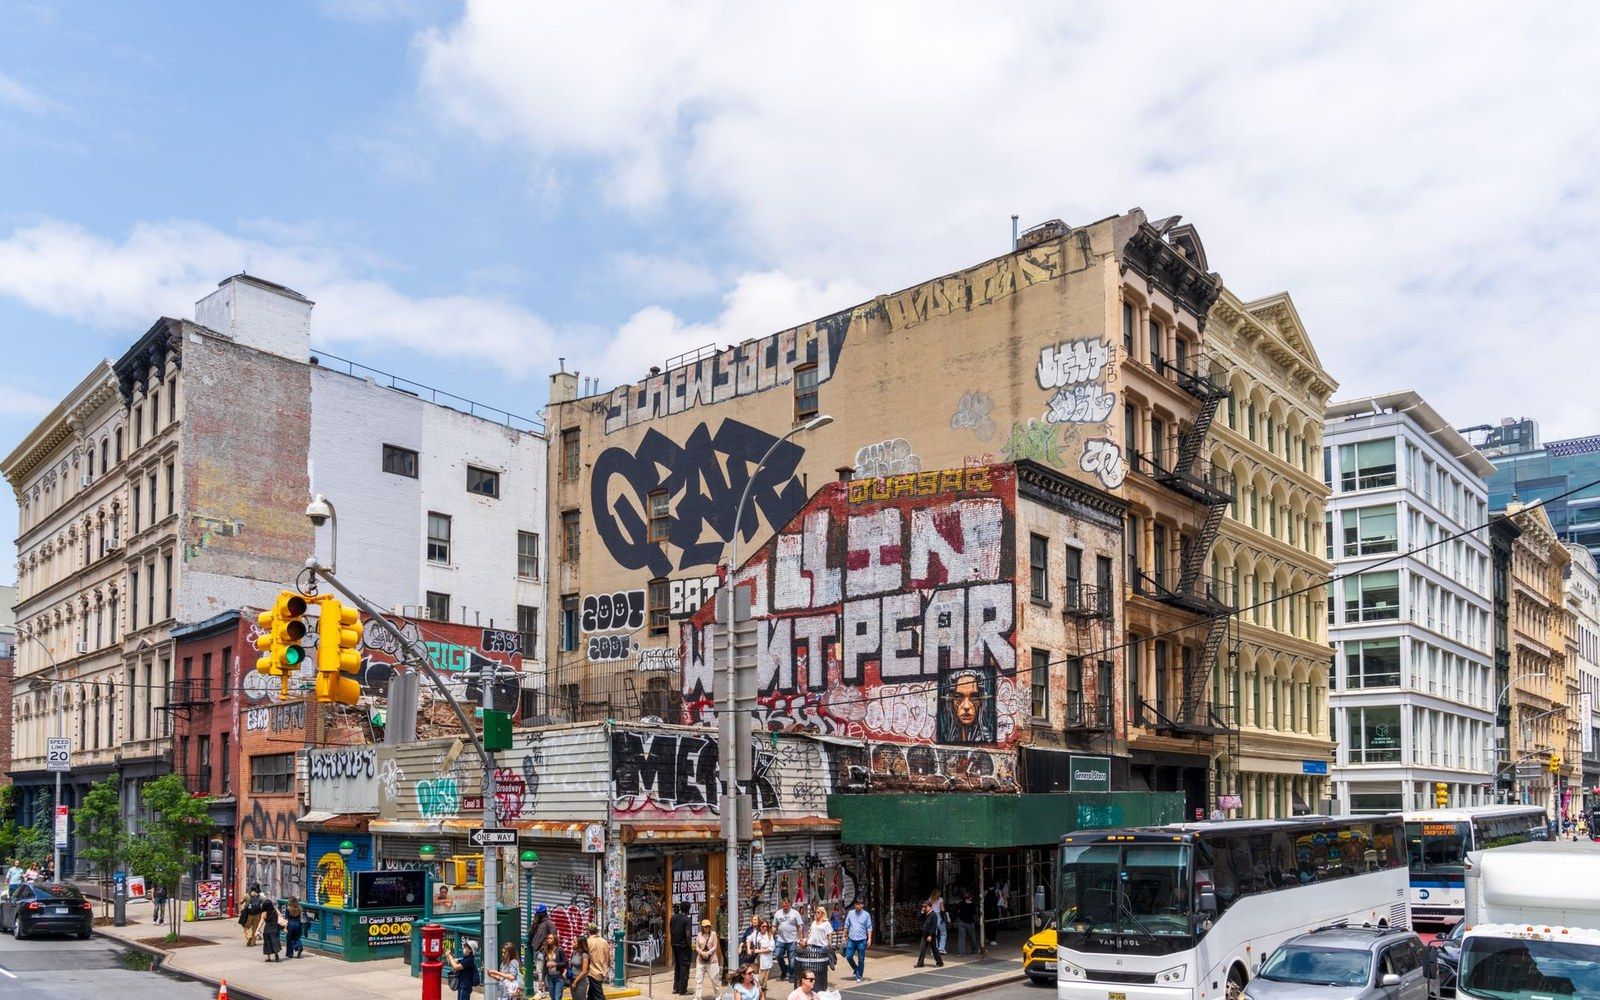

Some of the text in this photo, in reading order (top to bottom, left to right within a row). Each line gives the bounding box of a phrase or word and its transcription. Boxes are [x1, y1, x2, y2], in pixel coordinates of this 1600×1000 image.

[842, 581, 1015, 686] PEAR
[50, 752, 68, 760] 20
[496, 784, 522, 793] Broadway
[464, 799, 475, 808] Canal
